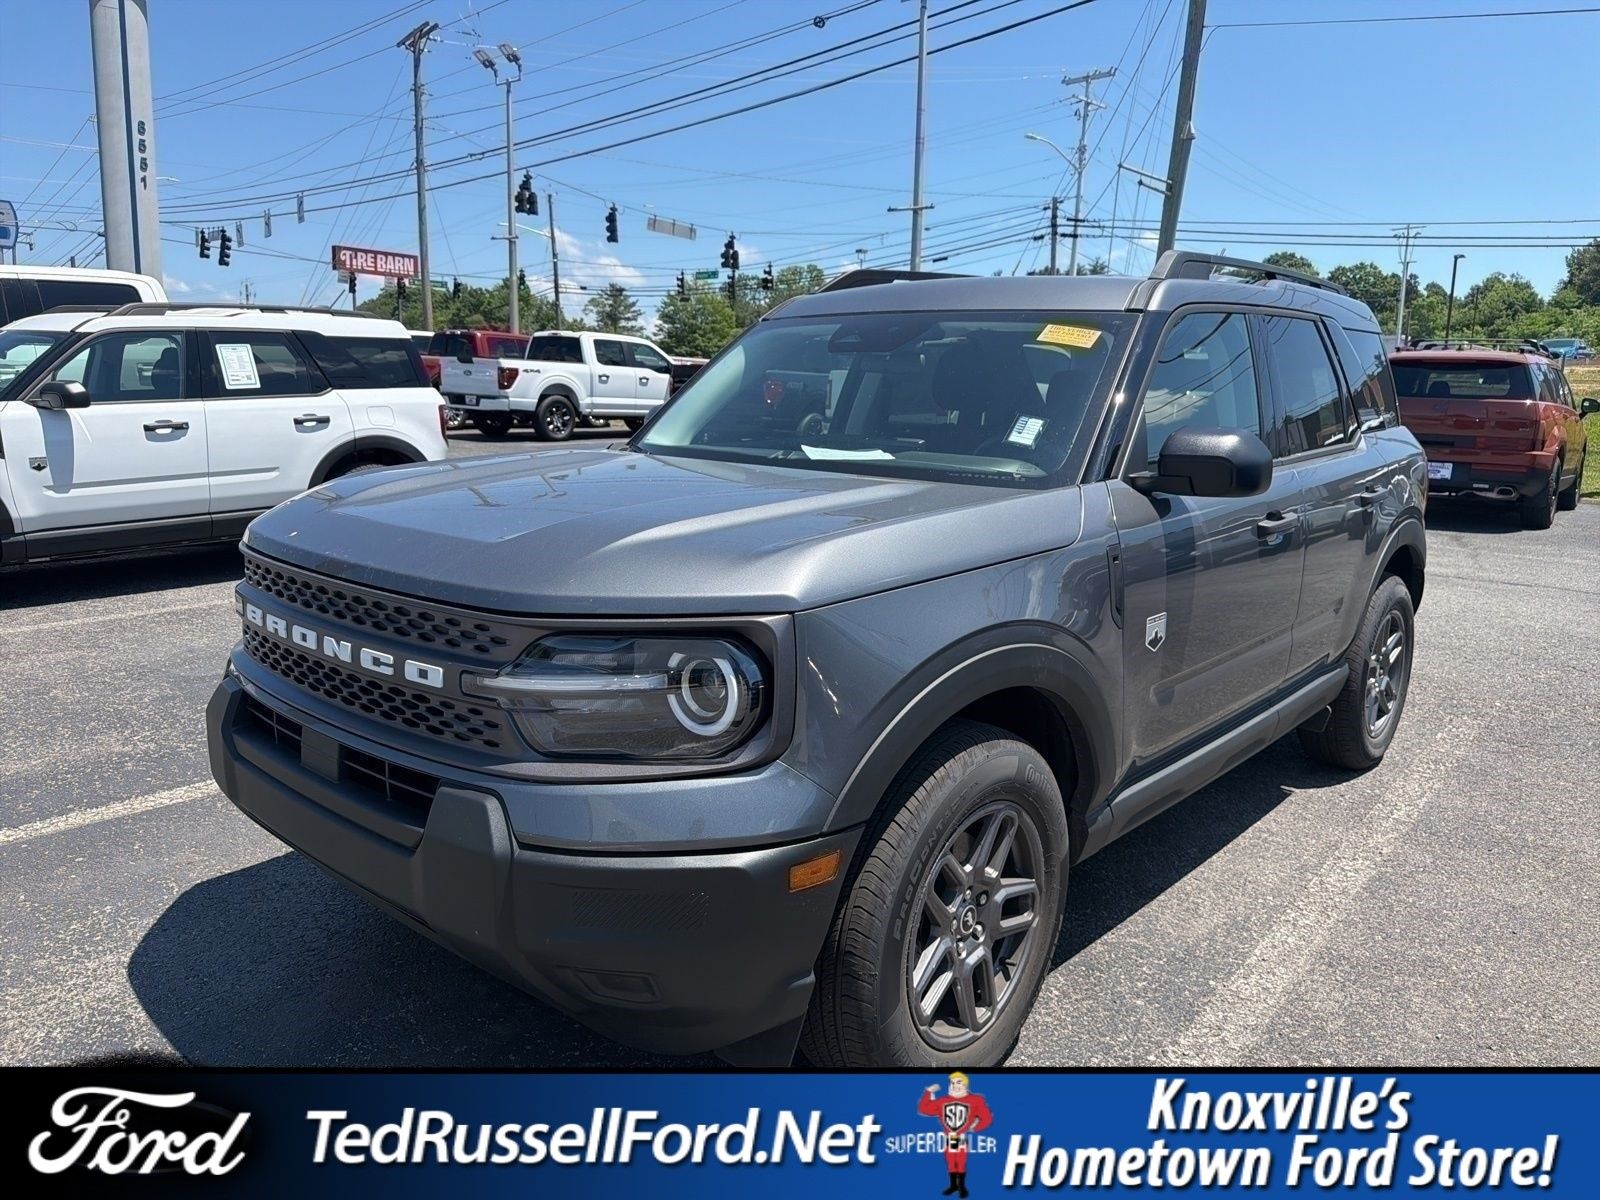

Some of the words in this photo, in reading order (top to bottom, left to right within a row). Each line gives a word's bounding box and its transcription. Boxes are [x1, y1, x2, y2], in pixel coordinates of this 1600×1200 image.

[340, 250, 375, 271] TIRE
[376, 254, 414, 275] BARN
[246, 602, 444, 689] BRONCO
